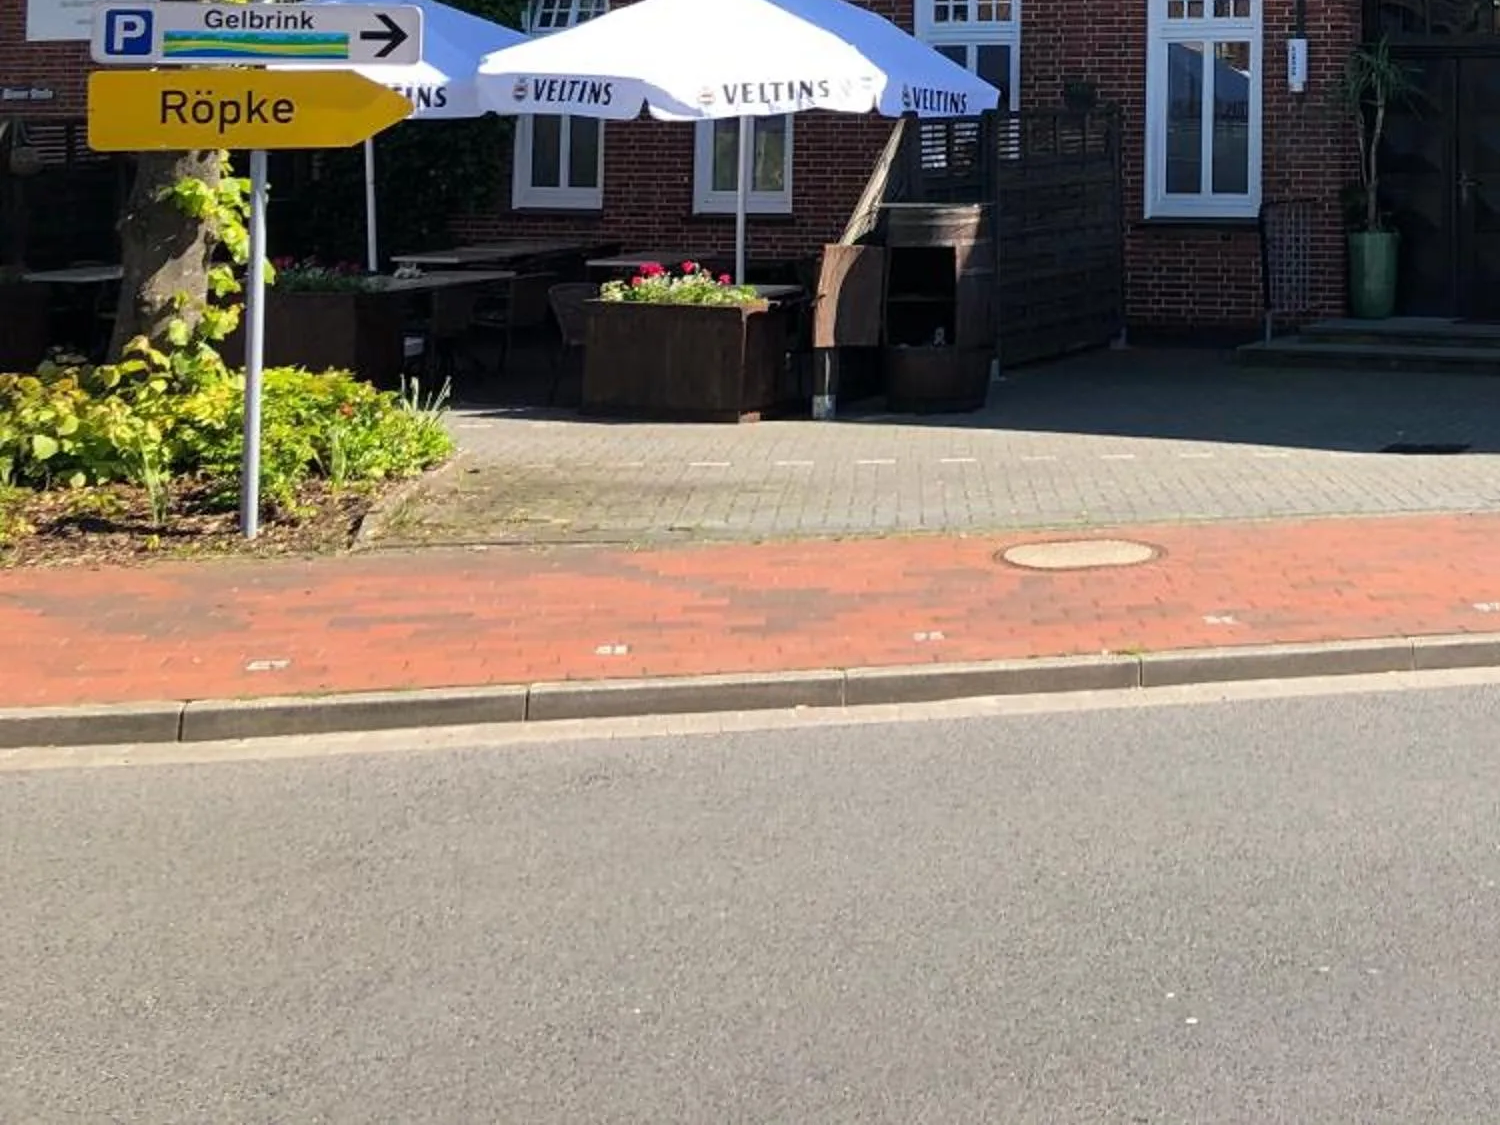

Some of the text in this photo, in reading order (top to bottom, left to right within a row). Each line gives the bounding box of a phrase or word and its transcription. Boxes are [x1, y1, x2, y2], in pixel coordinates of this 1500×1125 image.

[113, 14, 147, 52] P
[204, 9, 315, 30] Gelbrink
[533, 78, 613, 106] VELTINS
[722, 79, 830, 105] VELTINS
[912, 86, 967, 114] VELTINS
[160, 89, 295, 134] Röpke
